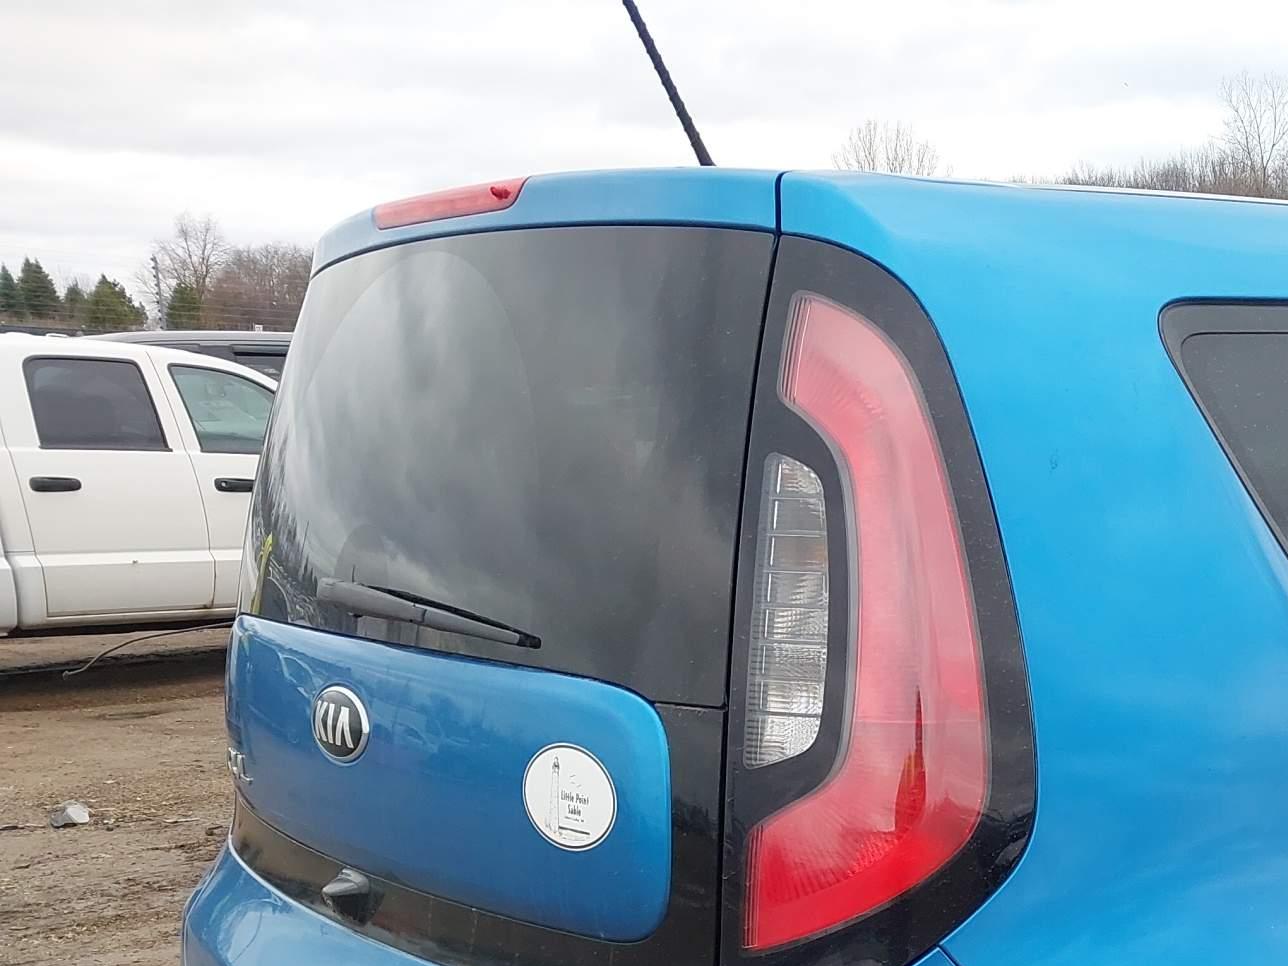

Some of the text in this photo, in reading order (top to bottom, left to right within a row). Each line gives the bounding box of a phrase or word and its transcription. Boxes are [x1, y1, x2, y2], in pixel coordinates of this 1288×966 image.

[314, 700, 355, 749] KIA
[561, 789, 589, 805] Little Point
[567, 803, 582, 816] Sable
